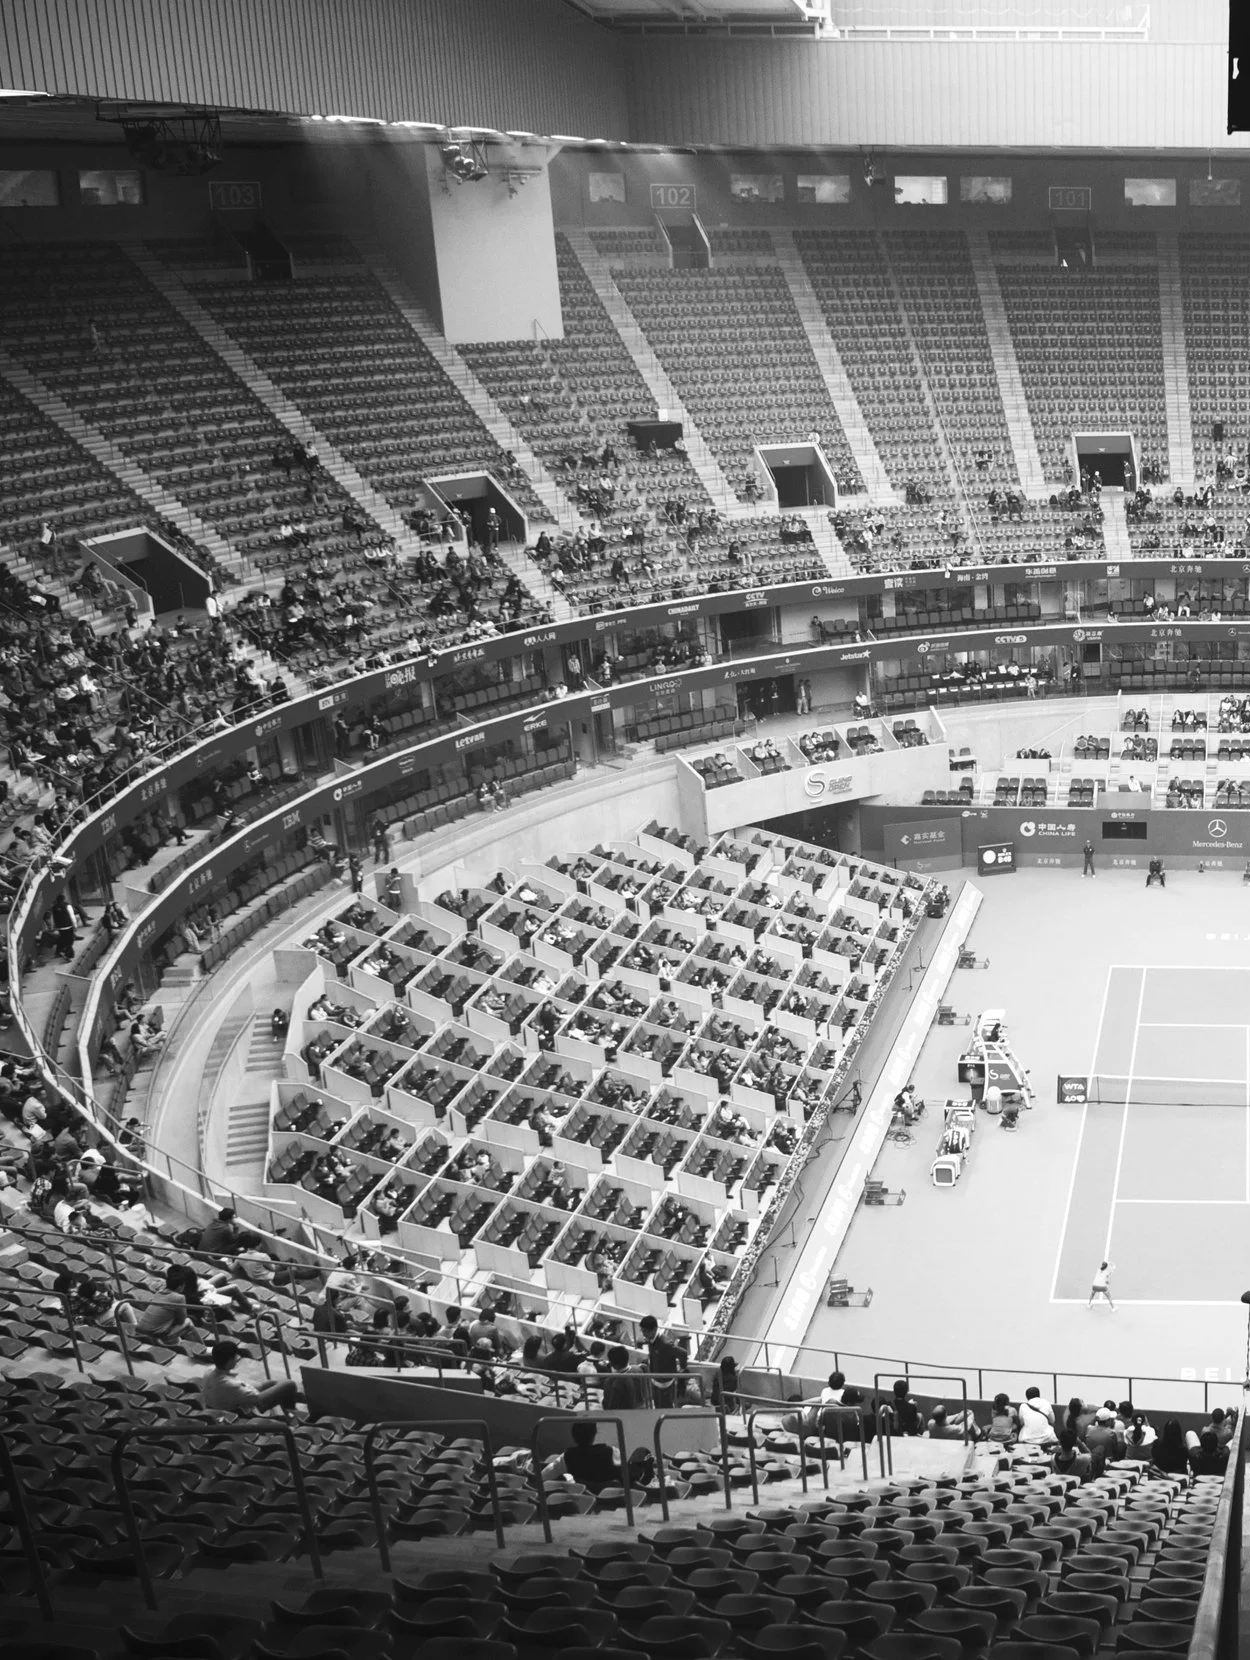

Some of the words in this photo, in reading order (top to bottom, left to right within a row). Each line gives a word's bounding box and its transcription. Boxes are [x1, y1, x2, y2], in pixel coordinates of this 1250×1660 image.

[213, 185, 256, 207] 103
[656, 187, 691, 206] 102
[1055, 189, 1087, 208] 101
[1170, 564, 1202, 574] 北京奔驰
[746, 591, 765, 600] CCTV
[1150, 629, 1183, 637] 北京奔驰
[840, 650, 869, 661] Jetstar
[523, 719, 547, 732] ERKE
[282, 809, 301, 830] IBM
[1038, 823, 1076, 831] 中国人寿
[1192, 840, 1243, 849] Mercedes-Benz
[1064, 1083, 1085, 1092] WTA
